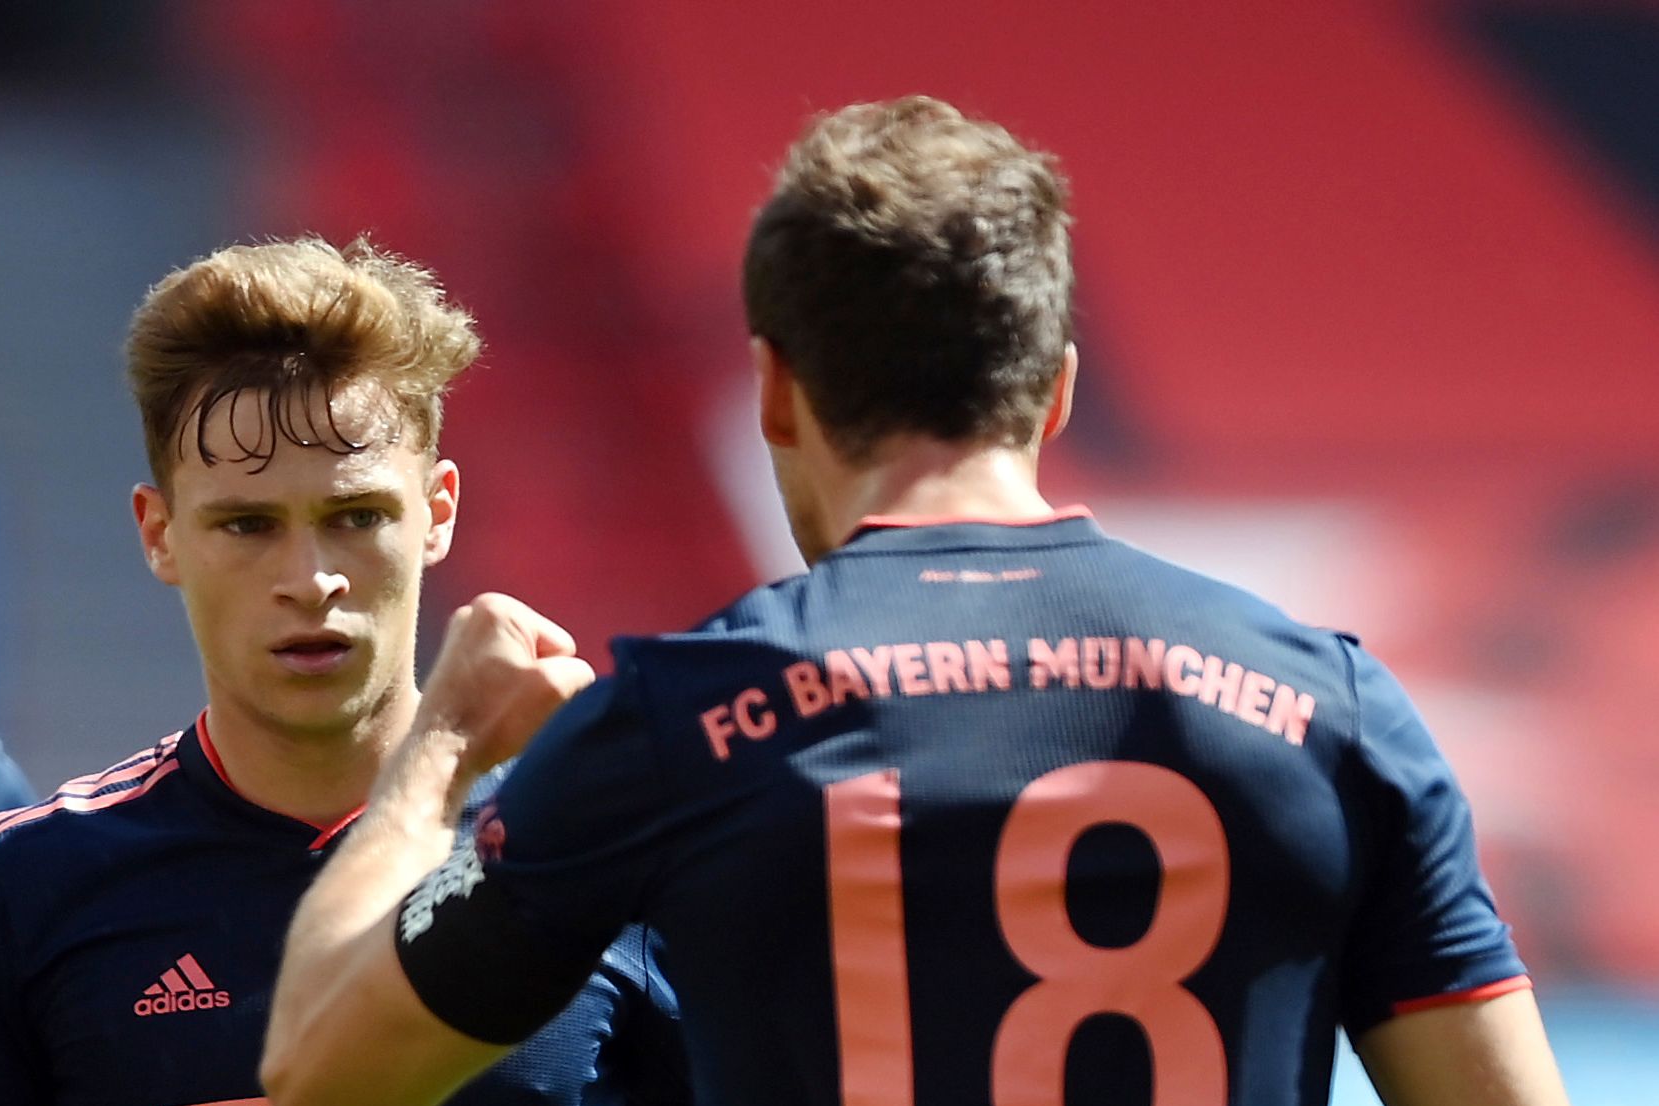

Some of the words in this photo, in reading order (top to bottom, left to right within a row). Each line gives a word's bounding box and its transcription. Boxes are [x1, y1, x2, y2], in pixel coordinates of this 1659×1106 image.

[699, 687, 779, 762] FC
[781, 638, 1012, 718] BAYERN
[134, 989, 230, 1016] adidas
